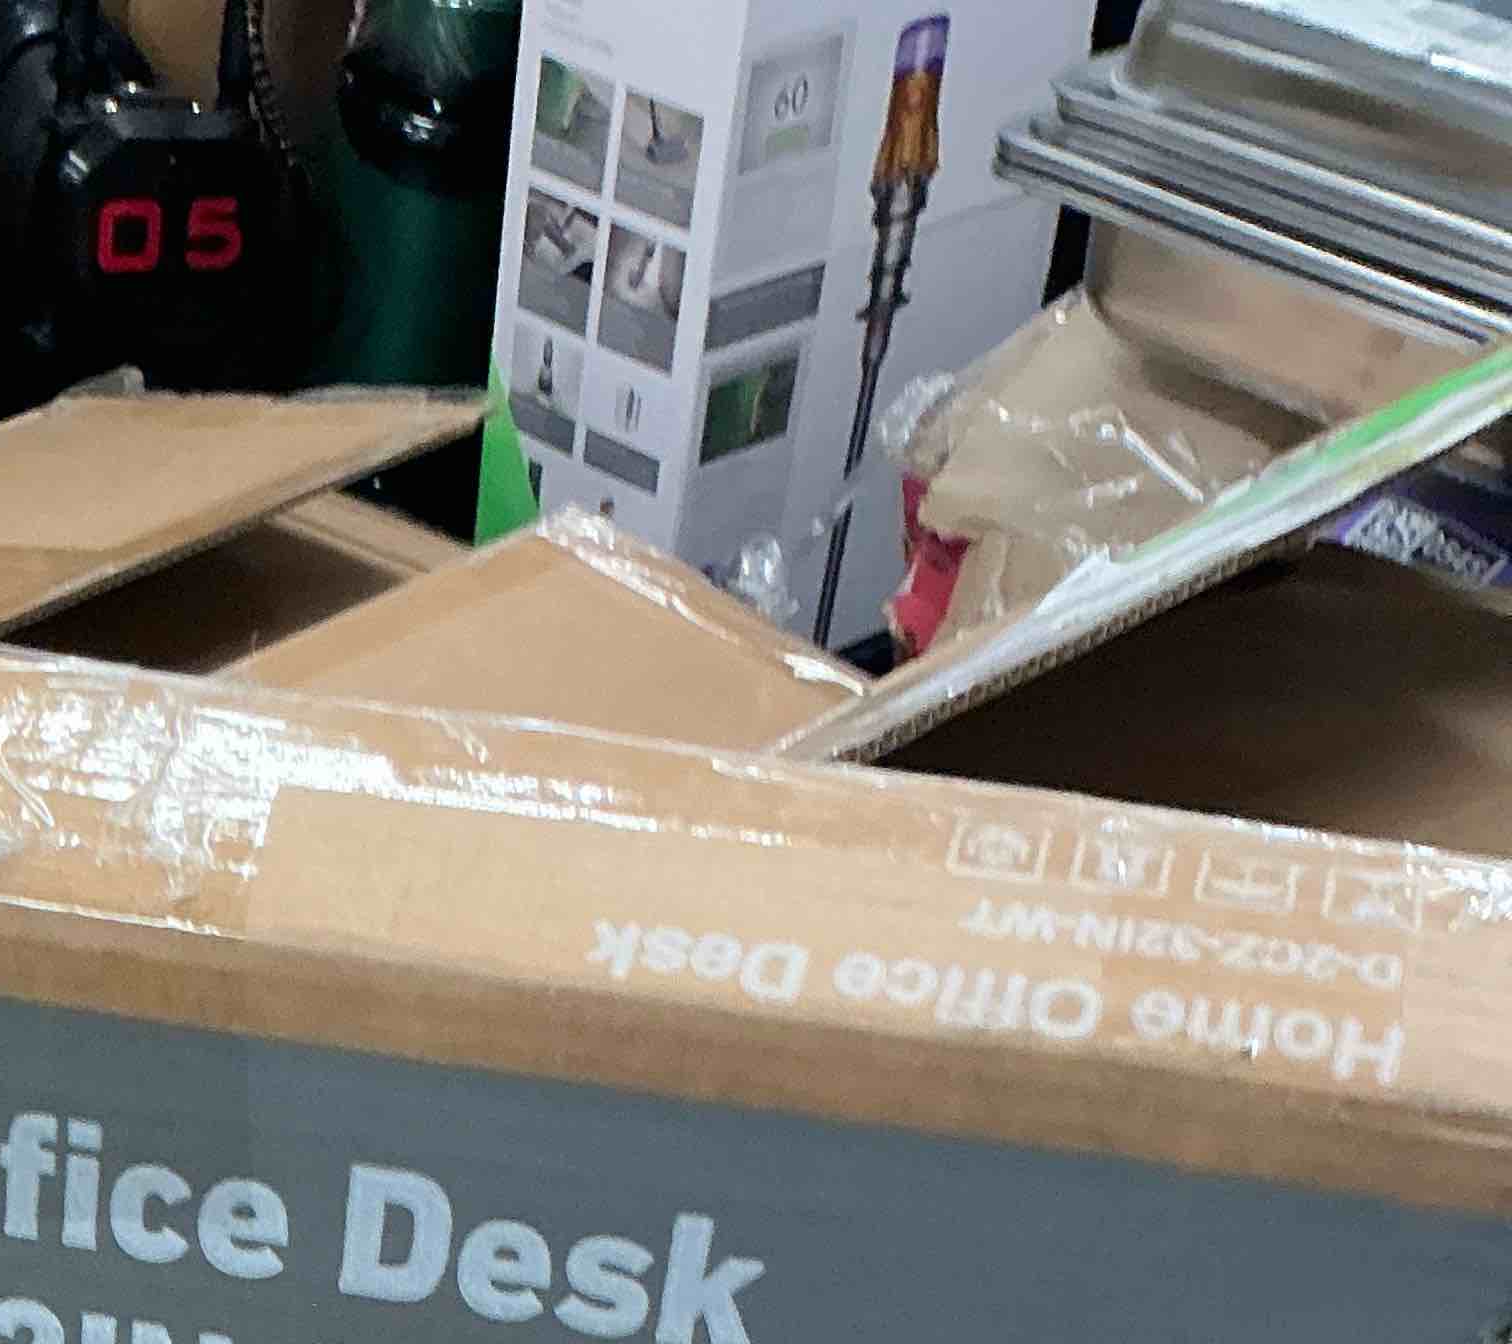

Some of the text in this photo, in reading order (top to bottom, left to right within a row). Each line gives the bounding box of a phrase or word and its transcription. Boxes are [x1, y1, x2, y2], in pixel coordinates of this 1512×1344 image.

[585, 917, 1405, 1087] Home Office Desk
[958, 897, 1402, 991] D-2CZ-32IN-WT
